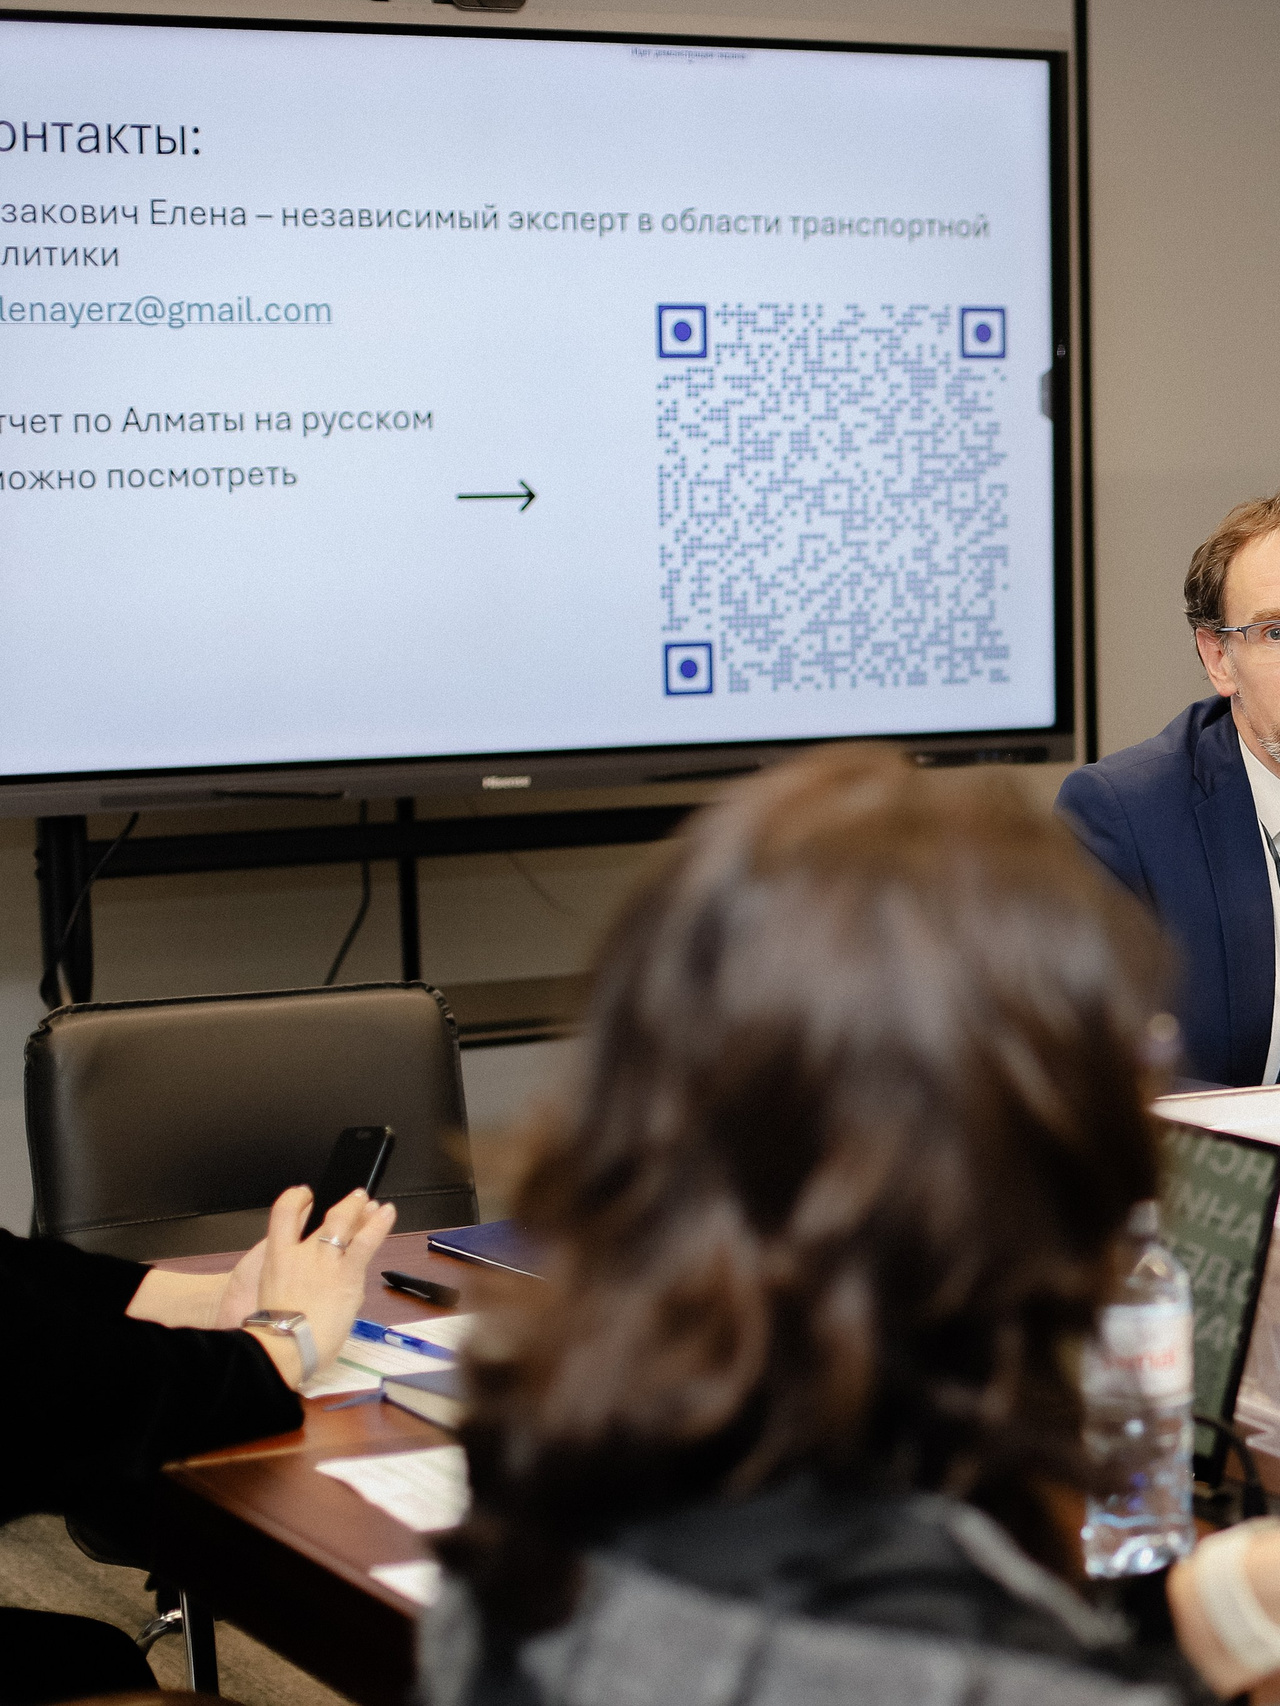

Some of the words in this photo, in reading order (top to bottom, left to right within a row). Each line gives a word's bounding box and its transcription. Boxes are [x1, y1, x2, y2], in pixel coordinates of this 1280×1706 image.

[1, 203, 138, 225] закович
[150, 199, 247, 226] Елена
[281, 204, 498, 230] независимый
[508, 210, 629, 238] эксперт
[638, 213, 653, 232] в
[660, 207, 781, 235] области
[789, 212, 990, 242] транспортной
[1, 245, 119, 267] литики
[0, 295, 332, 329] lenayerz@gmail.com
[74, 412, 112, 434] по
[121, 407, 244, 433] Алматы
[255, 411, 292, 432] на
[302, 409, 434, 438] русском
[0, 469, 96, 490] ожно
[107, 466, 297, 493] посмотреть
